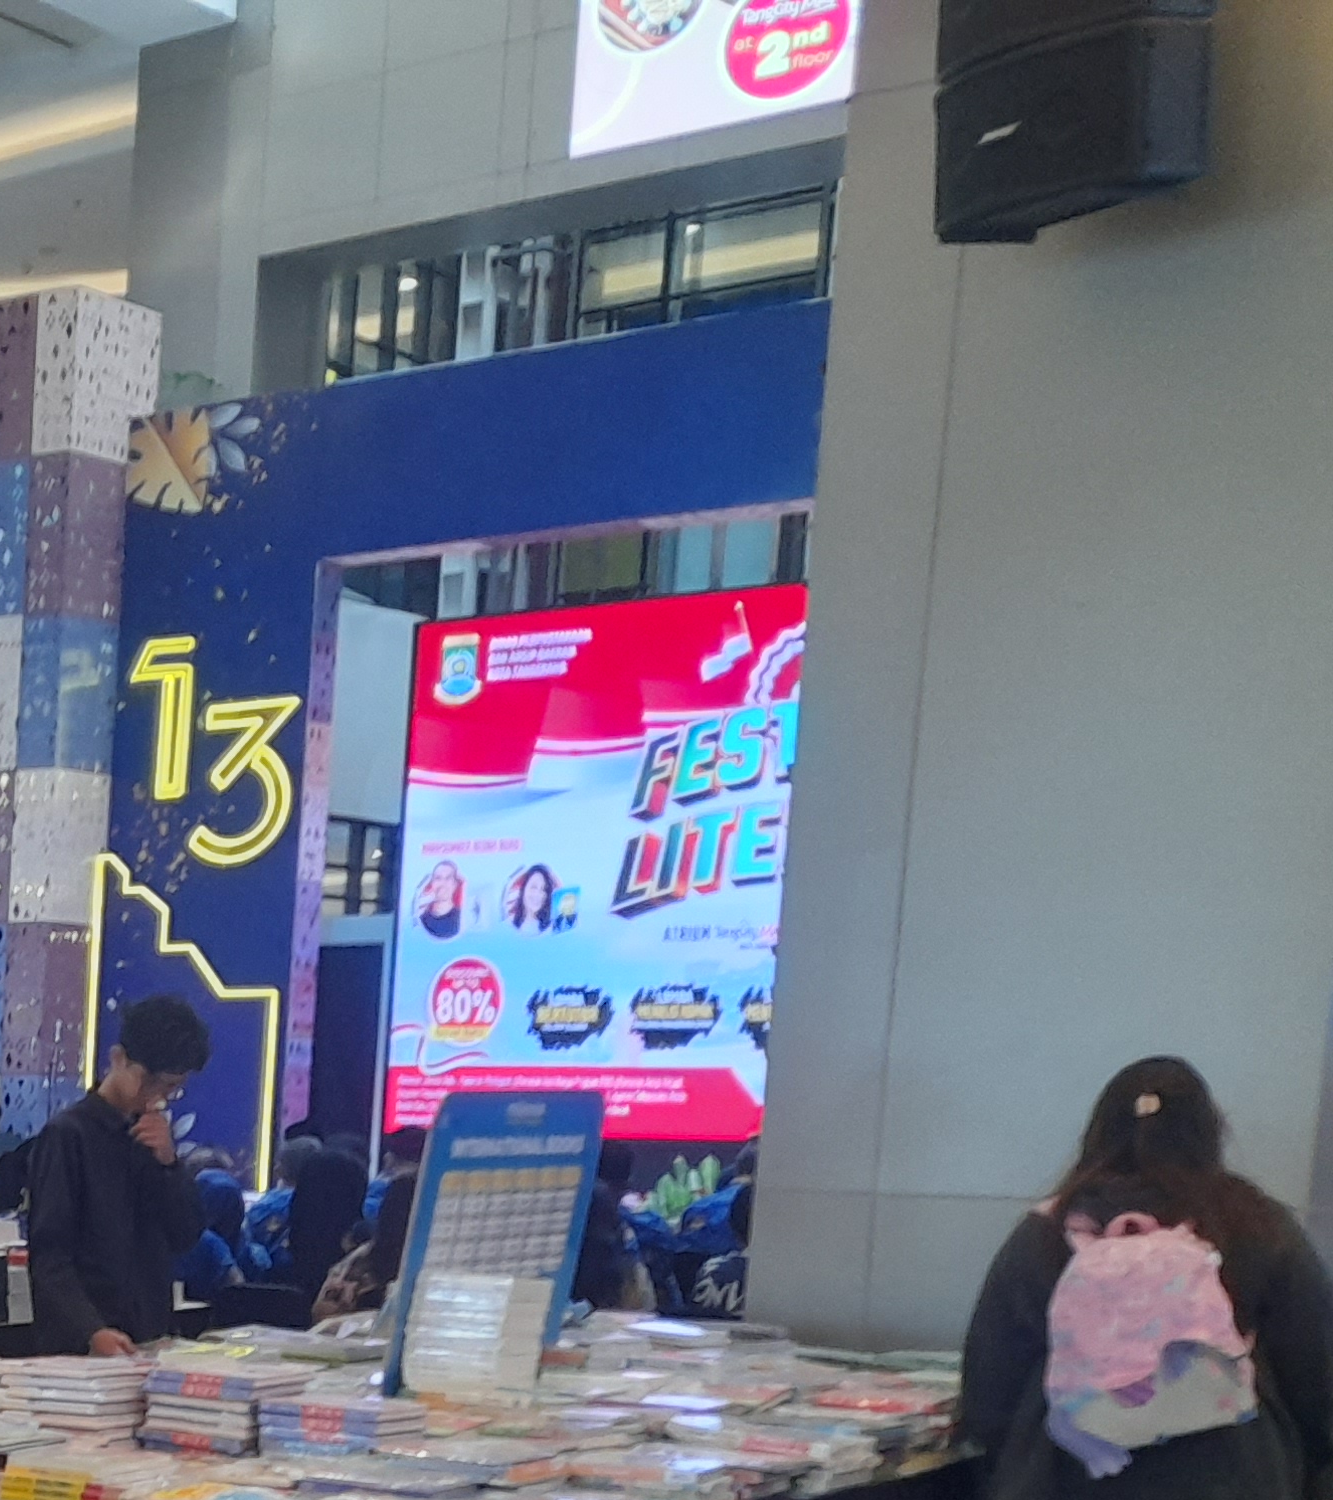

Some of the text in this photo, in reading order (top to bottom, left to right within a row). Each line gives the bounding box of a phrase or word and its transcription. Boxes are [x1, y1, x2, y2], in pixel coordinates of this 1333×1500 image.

[792, 50, 833, 68] floor
[130, 635, 301, 866] 13
[611, 802, 782, 912] LITE
[436, 988, 495, 1024] 80%
